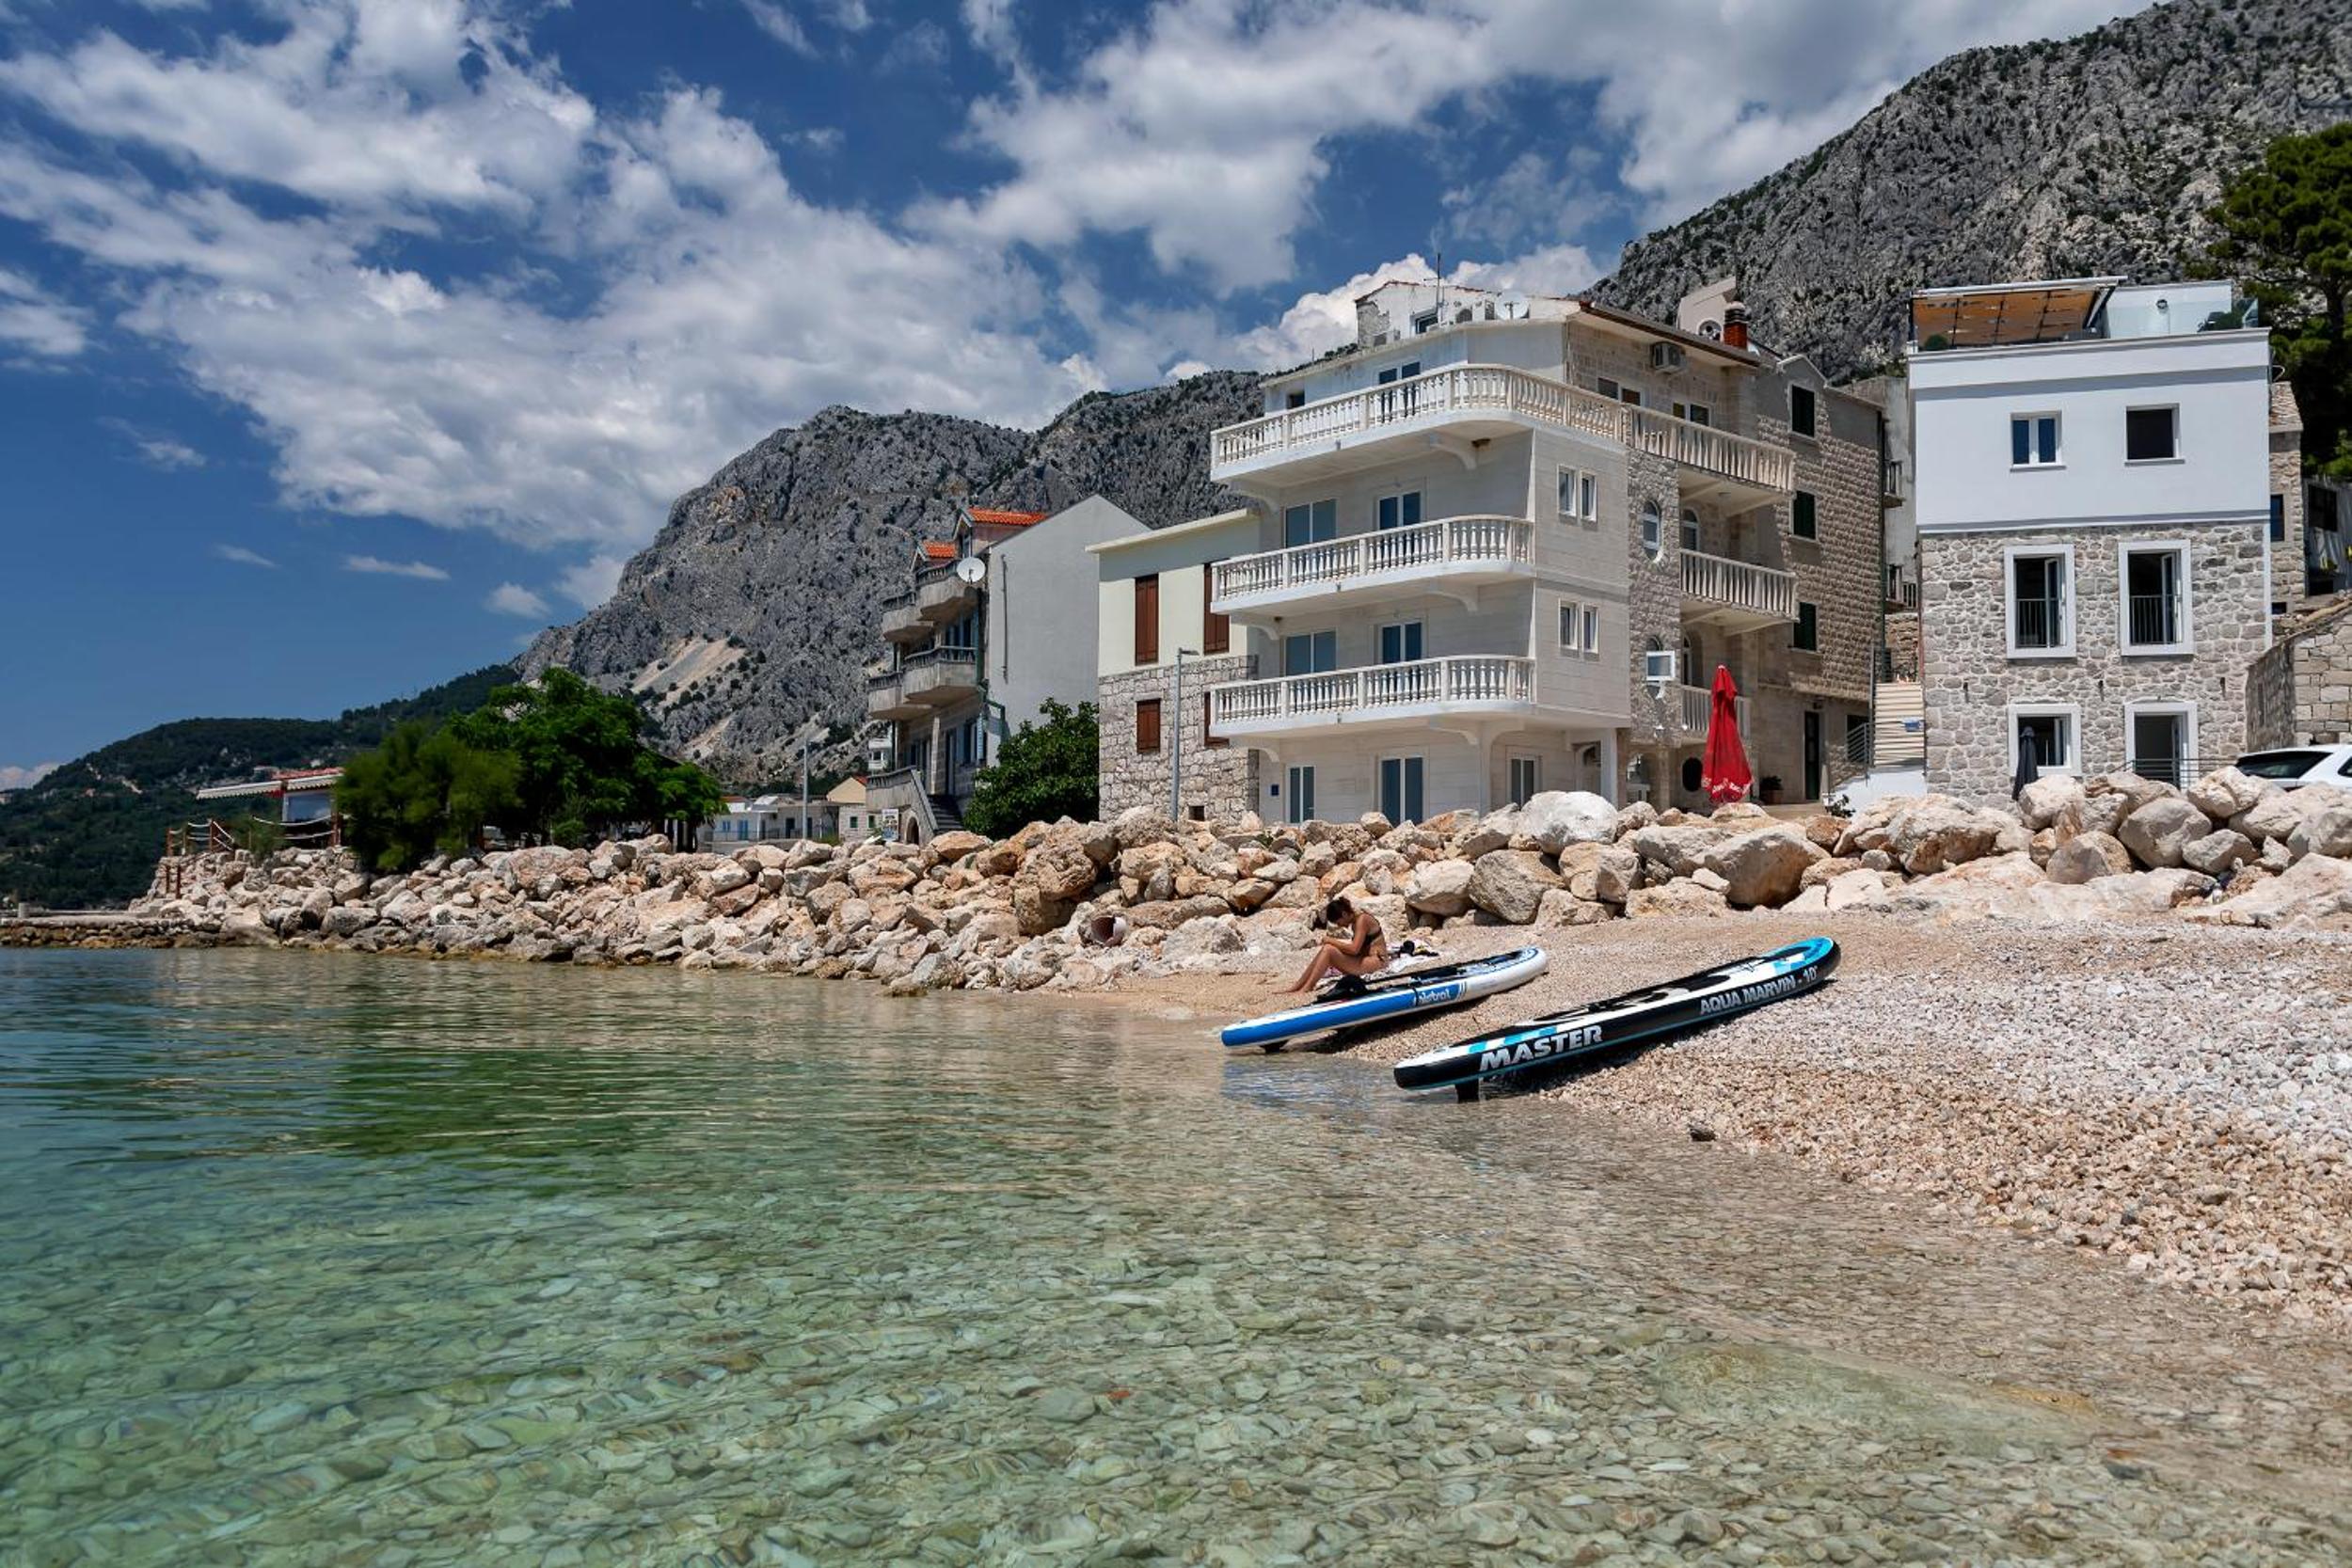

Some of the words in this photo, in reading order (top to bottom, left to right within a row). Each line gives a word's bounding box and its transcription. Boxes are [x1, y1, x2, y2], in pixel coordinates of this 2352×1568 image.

[1700, 992, 1740, 1015] AQUA
[1742, 974, 1796, 1004] MARVIN
[1479, 1024, 1603, 1072] MASTER
